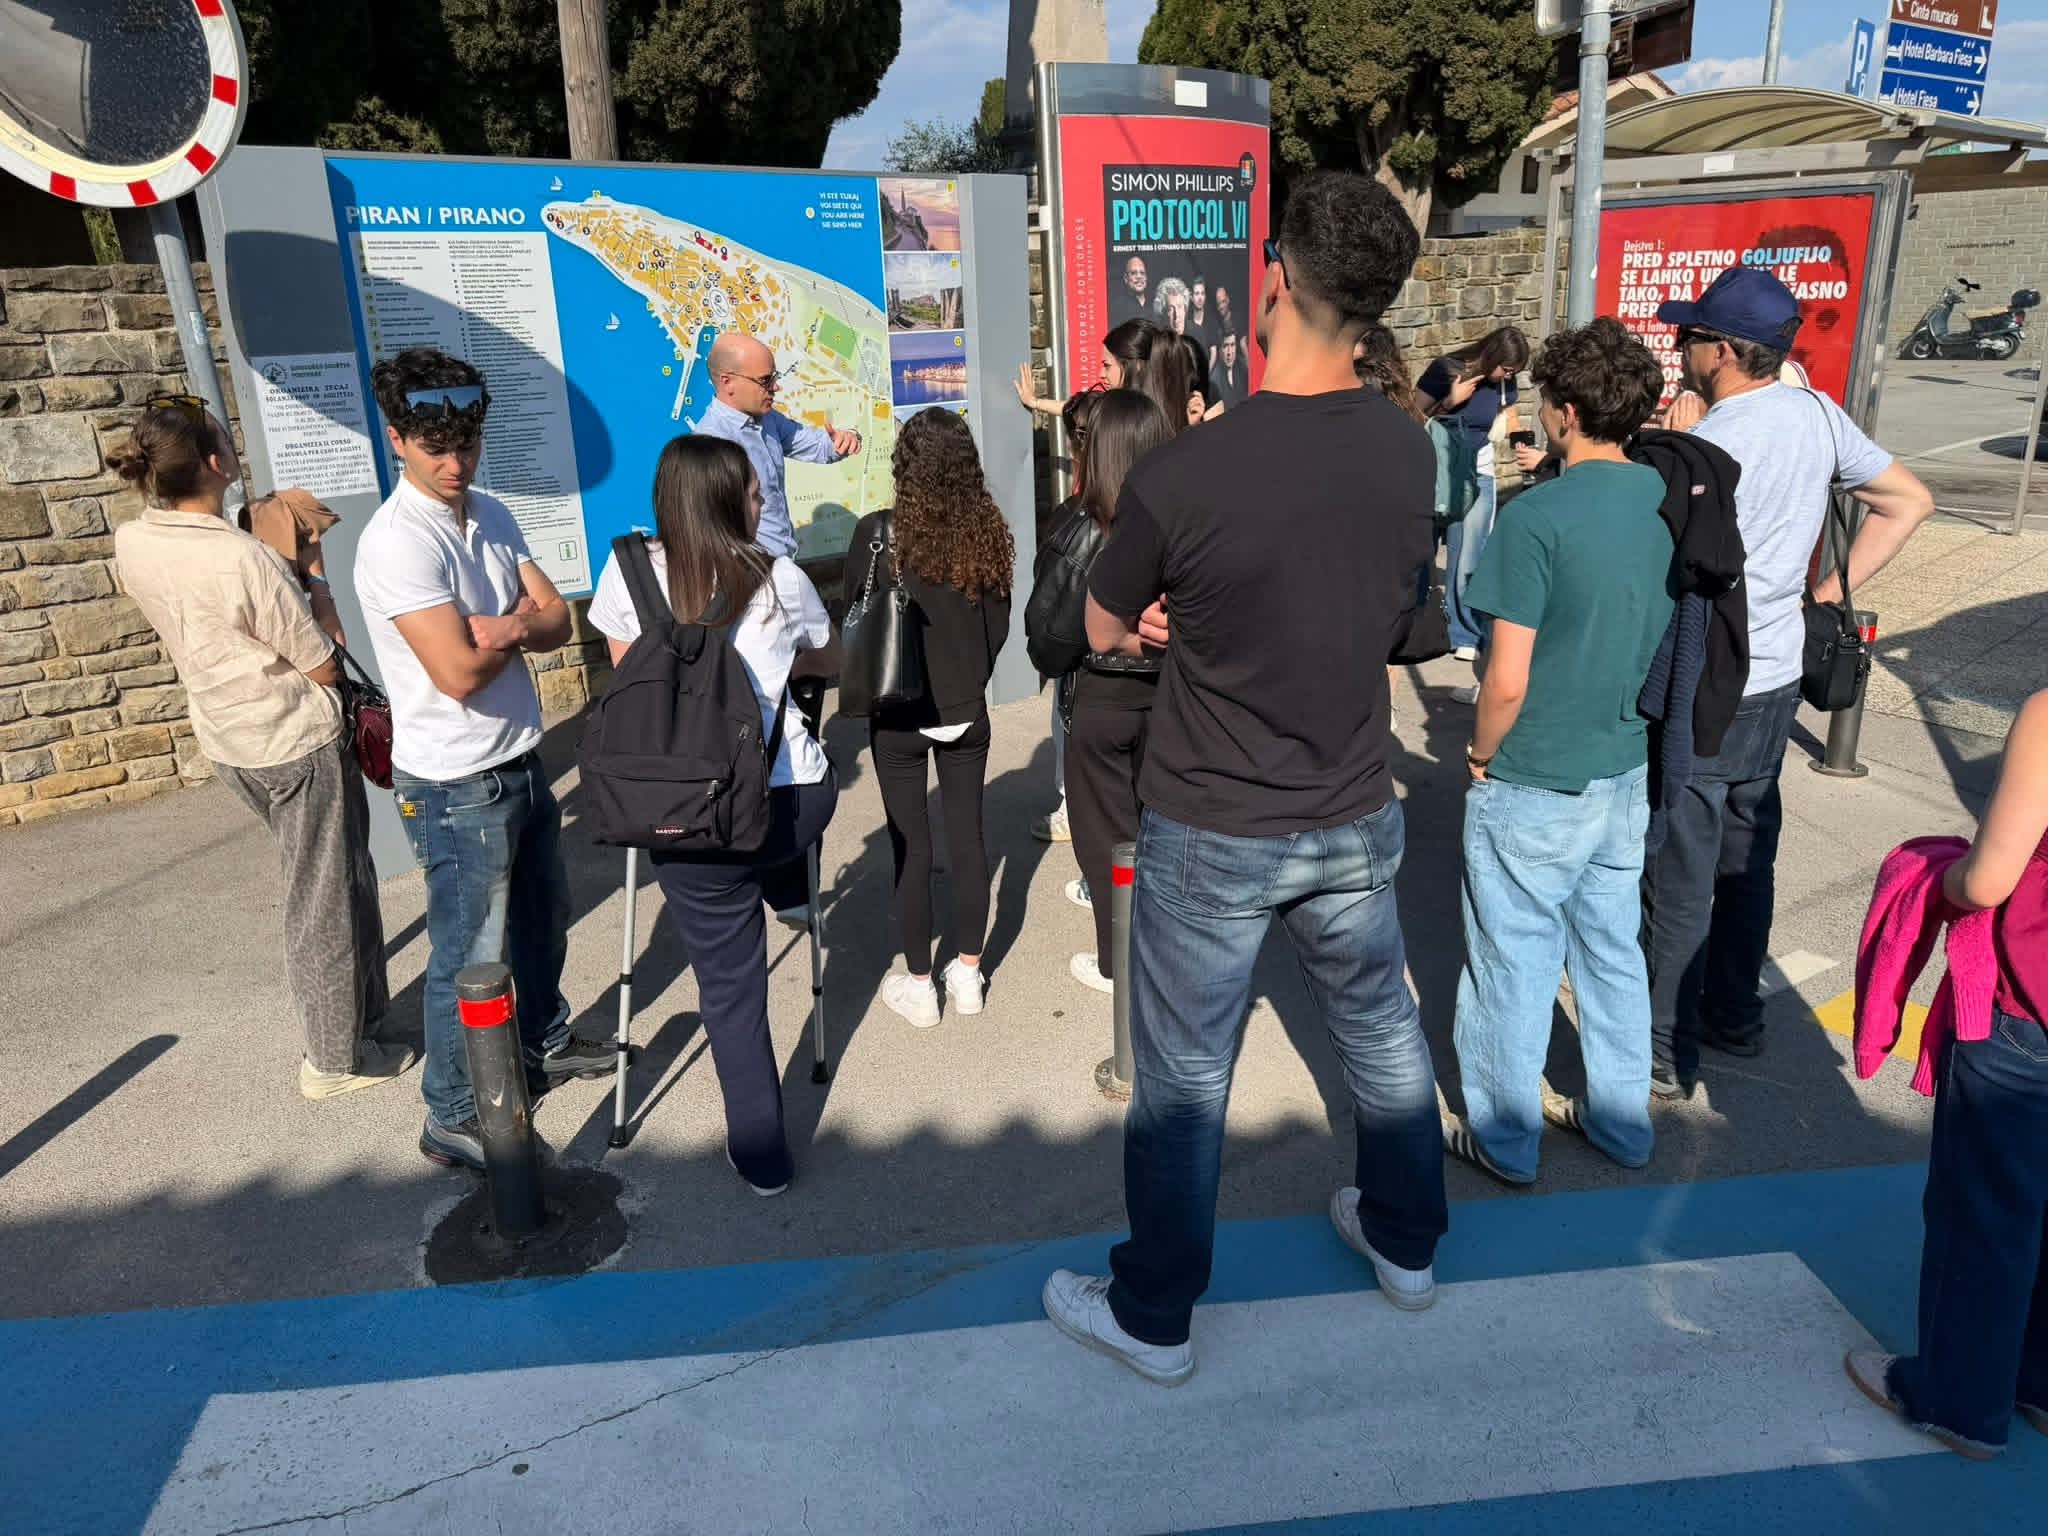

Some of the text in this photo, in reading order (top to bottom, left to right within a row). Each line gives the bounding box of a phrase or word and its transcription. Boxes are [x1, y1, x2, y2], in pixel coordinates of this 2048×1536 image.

[1911, 1, 1930, 20] Cinta
[1852, 31, 1868, 88] P
[1904, 40, 1973, 67] Hotel Barbara Fiesa
[1897, 88, 1938, 108] Hotel Fiesa
[1111, 173, 1170, 191] SIMON
[1175, 174, 1234, 192] PHILLIPS
[345, 205, 421, 225] PIRAN
[439, 207, 526, 225] PIRANO
[1112, 199, 1247, 241] PROTOCOL VI
[1624, 240, 1654, 253] Dejstvo
[1622, 246, 1832, 268] PRED SPLETNO GOLJUFIJO
[1621, 270, 1639, 285] SE
[1642, 268, 1695, 284] LAHKO
[1779, 265, 1798, 282] LE
[1618, 285, 1663, 302] TAKO,
[1669, 285, 1693, 301] DA
